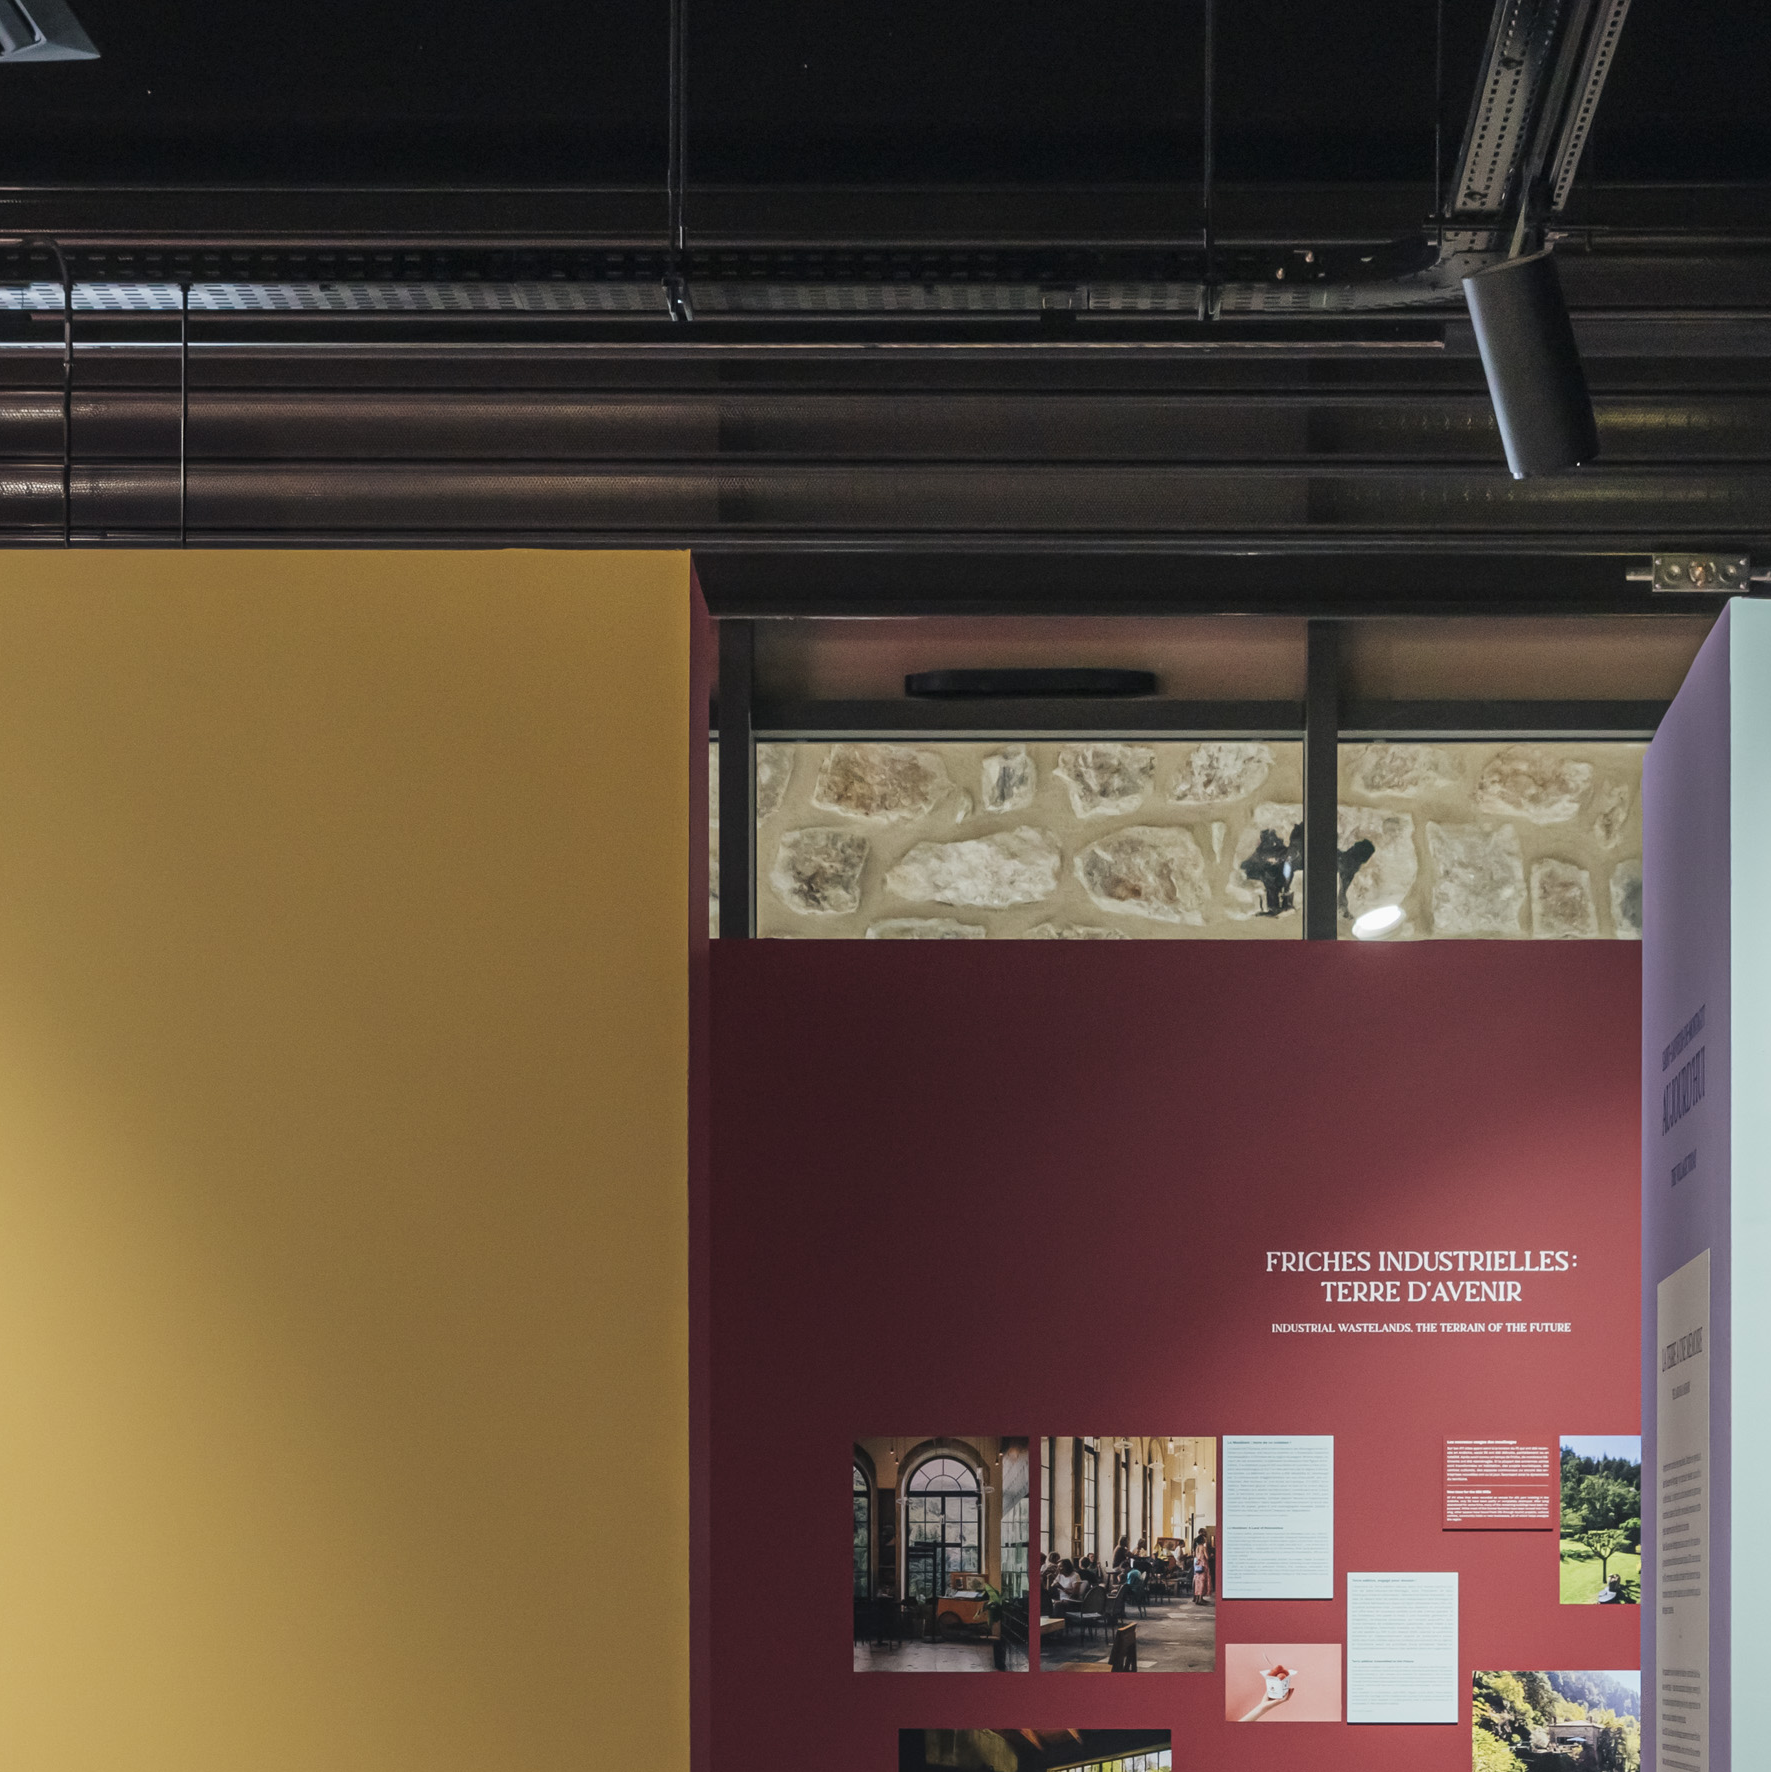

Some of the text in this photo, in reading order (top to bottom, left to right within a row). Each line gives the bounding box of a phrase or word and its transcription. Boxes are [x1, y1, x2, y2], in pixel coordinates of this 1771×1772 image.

[1266, 1251, 1371, 1272] FRICHES
[1320, 1281, 1522, 1302] TERRE D'AVENIR
[1271, 1323, 1335, 1333] INDUSTRIAL
[1415, 1322, 1438, 1333] THE
[1439, 1322, 1486, 1333] TERRAIN
[1487, 1322, 1504, 1333] OF
[1504, 1322, 1528, 1333] THE
[1529, 1322, 1572, 1333] FUTURE
